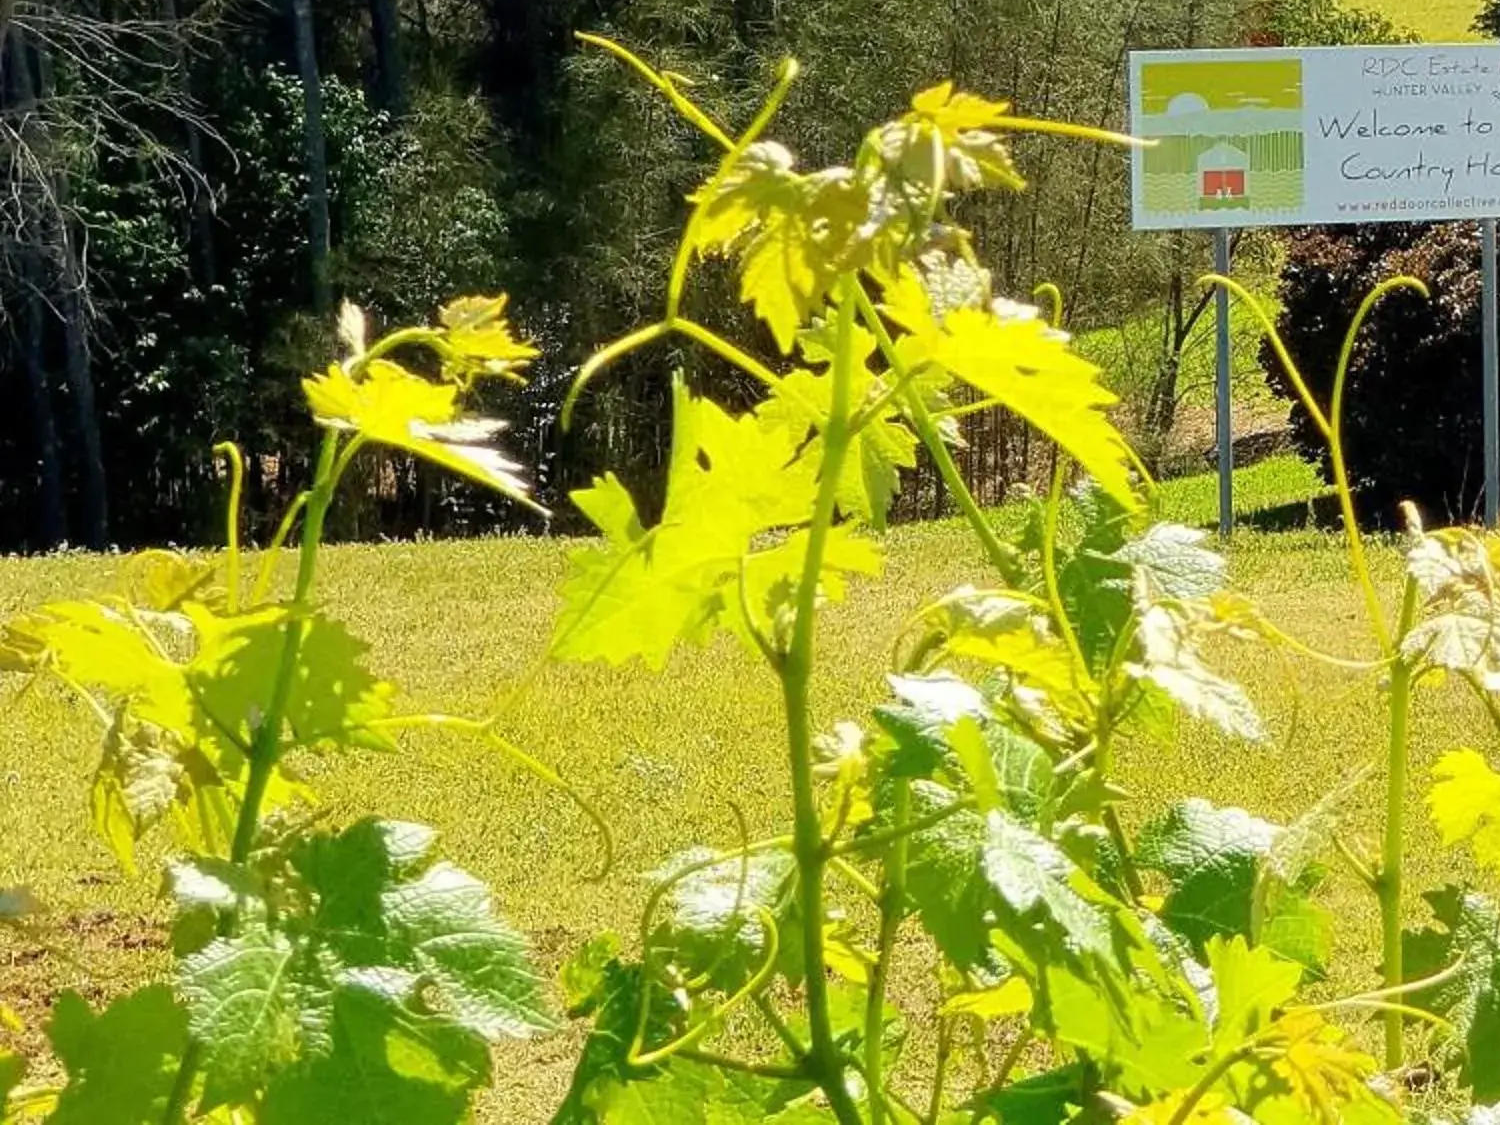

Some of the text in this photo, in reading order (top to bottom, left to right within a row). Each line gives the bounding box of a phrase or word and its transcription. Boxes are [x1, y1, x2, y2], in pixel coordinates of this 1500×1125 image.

[1362, 53, 1491, 77] RDC Estate
[1431, 81, 1482, 96] VALLEY
[1319, 107, 1448, 139] Welcome
[1462, 107, 1493, 135] to
[1340, 150, 1455, 193] Country
